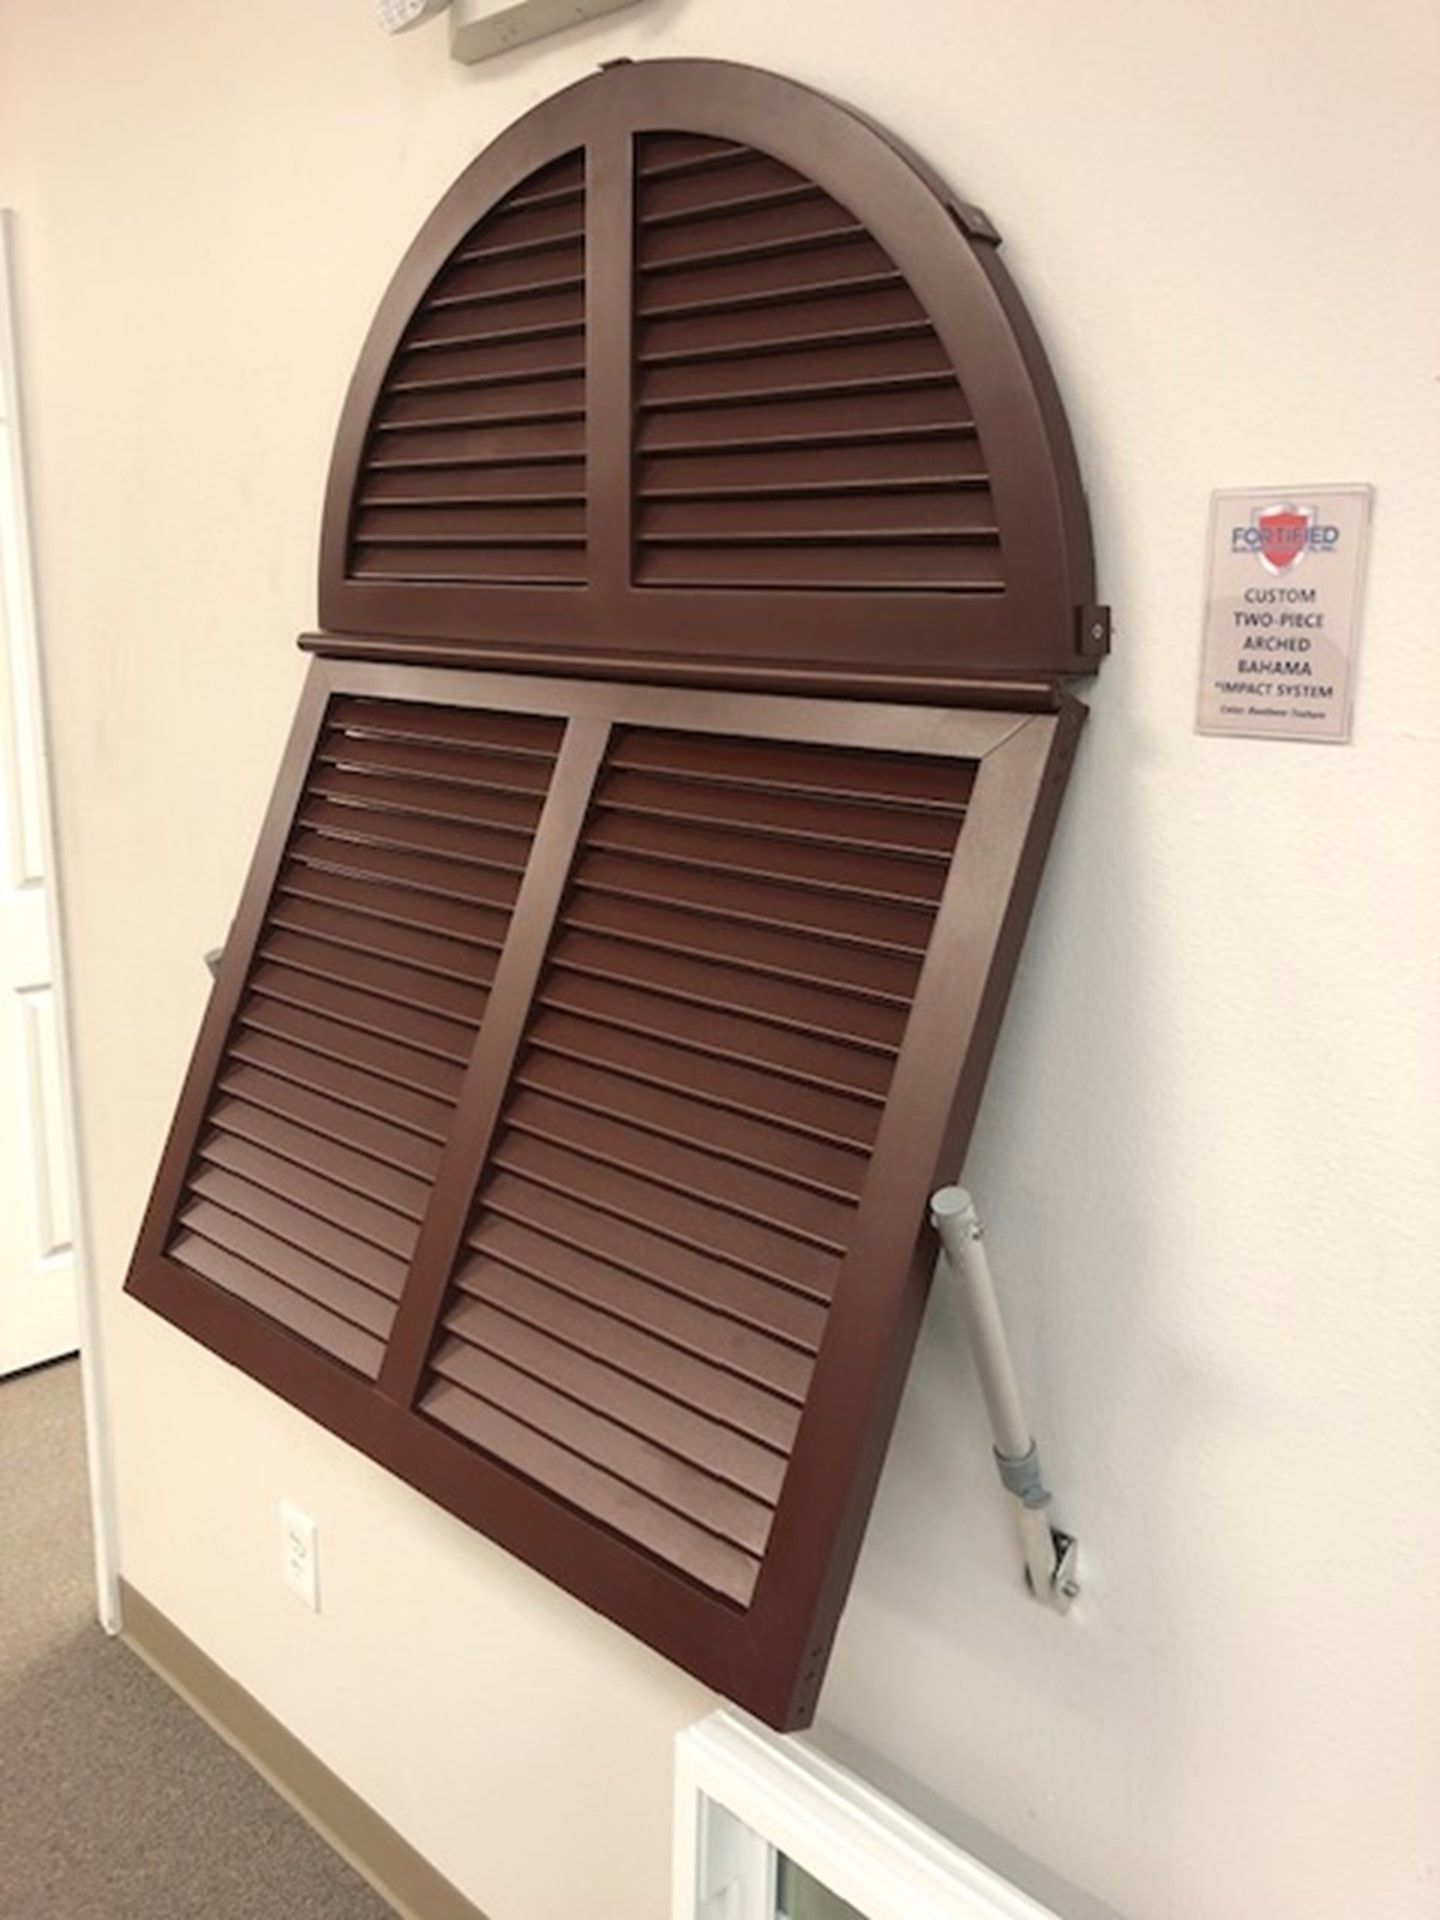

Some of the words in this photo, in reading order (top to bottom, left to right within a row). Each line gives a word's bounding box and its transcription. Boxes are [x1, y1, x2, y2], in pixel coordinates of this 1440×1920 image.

[1232, 526, 1339, 544] FORTIFIED
[1244, 588, 1316, 603] CUSTOM
[1234, 611, 1324, 628] TWO-PIECE
[1243, 636, 1311, 652] ARCHED
[1238, 660, 1312, 676] BAHAMA
[1276, 684, 1334, 698] SYSTEM
